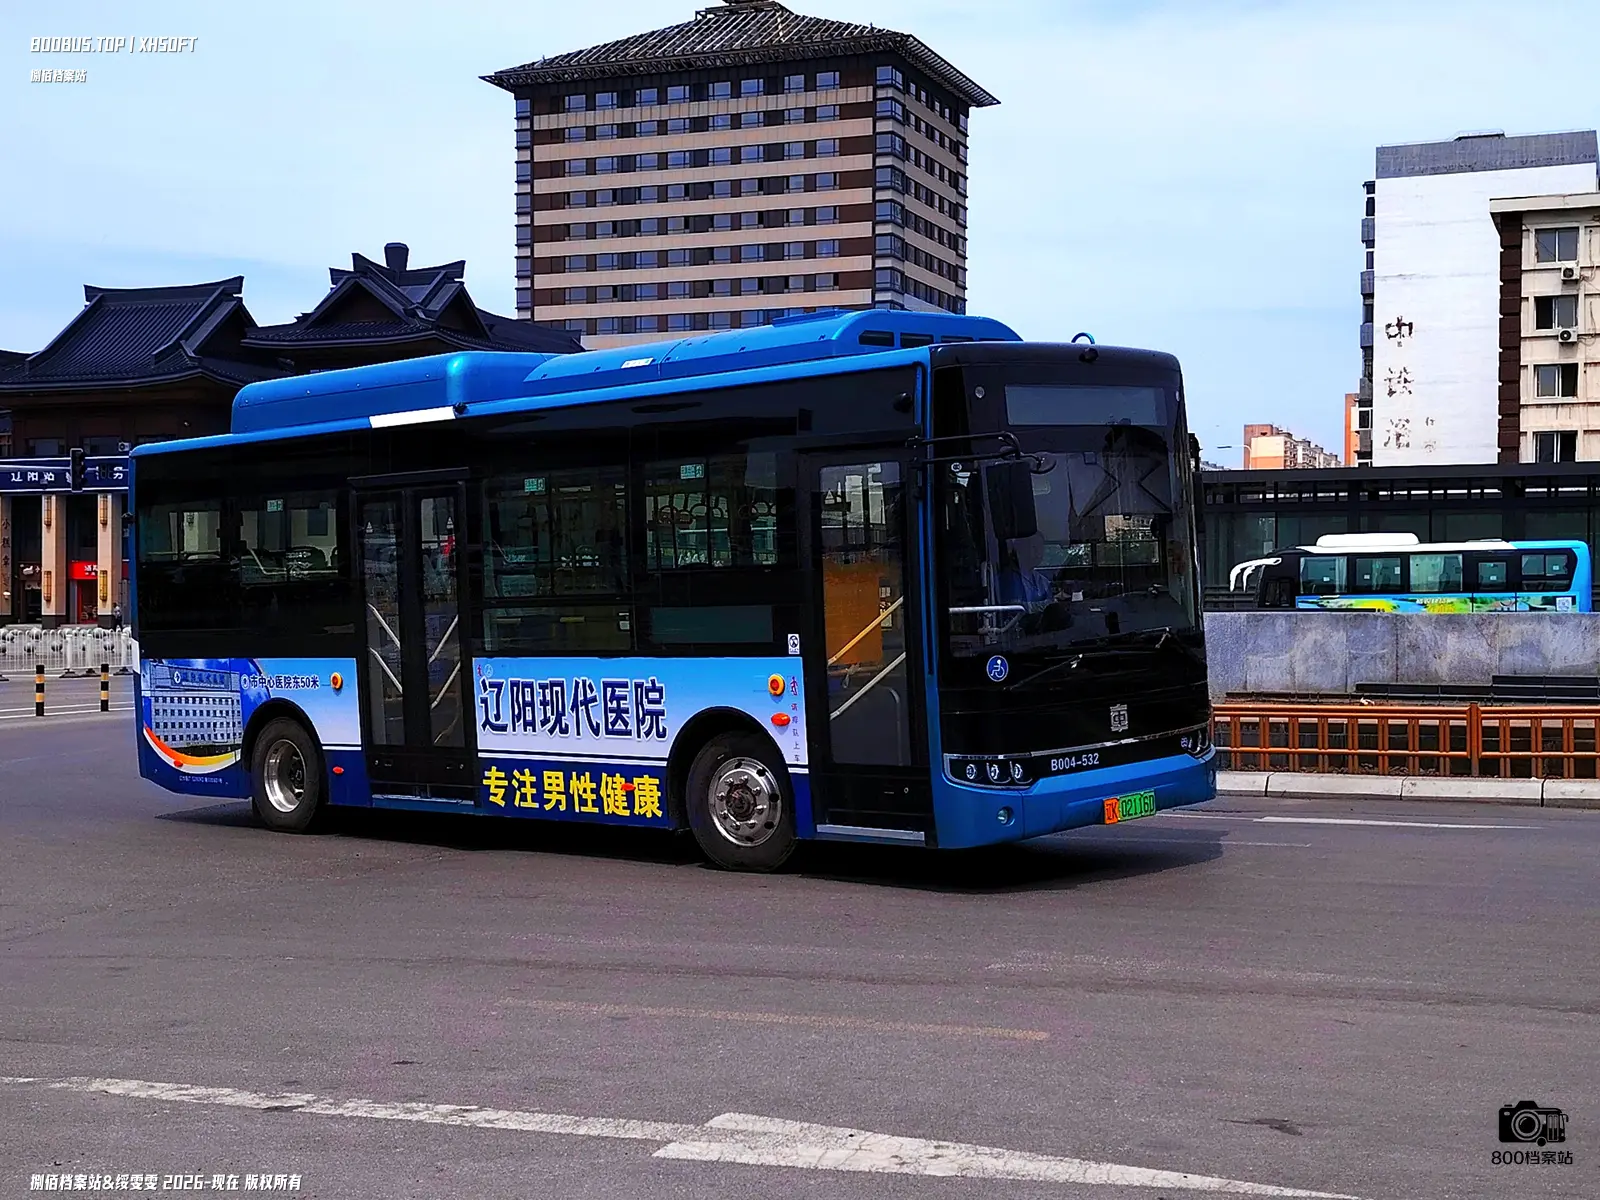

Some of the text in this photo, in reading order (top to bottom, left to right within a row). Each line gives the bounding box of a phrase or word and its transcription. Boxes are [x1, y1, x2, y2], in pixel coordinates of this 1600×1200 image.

[479, 677, 667, 740] 辽阳现代医院
[1051, 753, 1100, 771] B004-532
[482, 766, 663, 818] 专注男性健康
